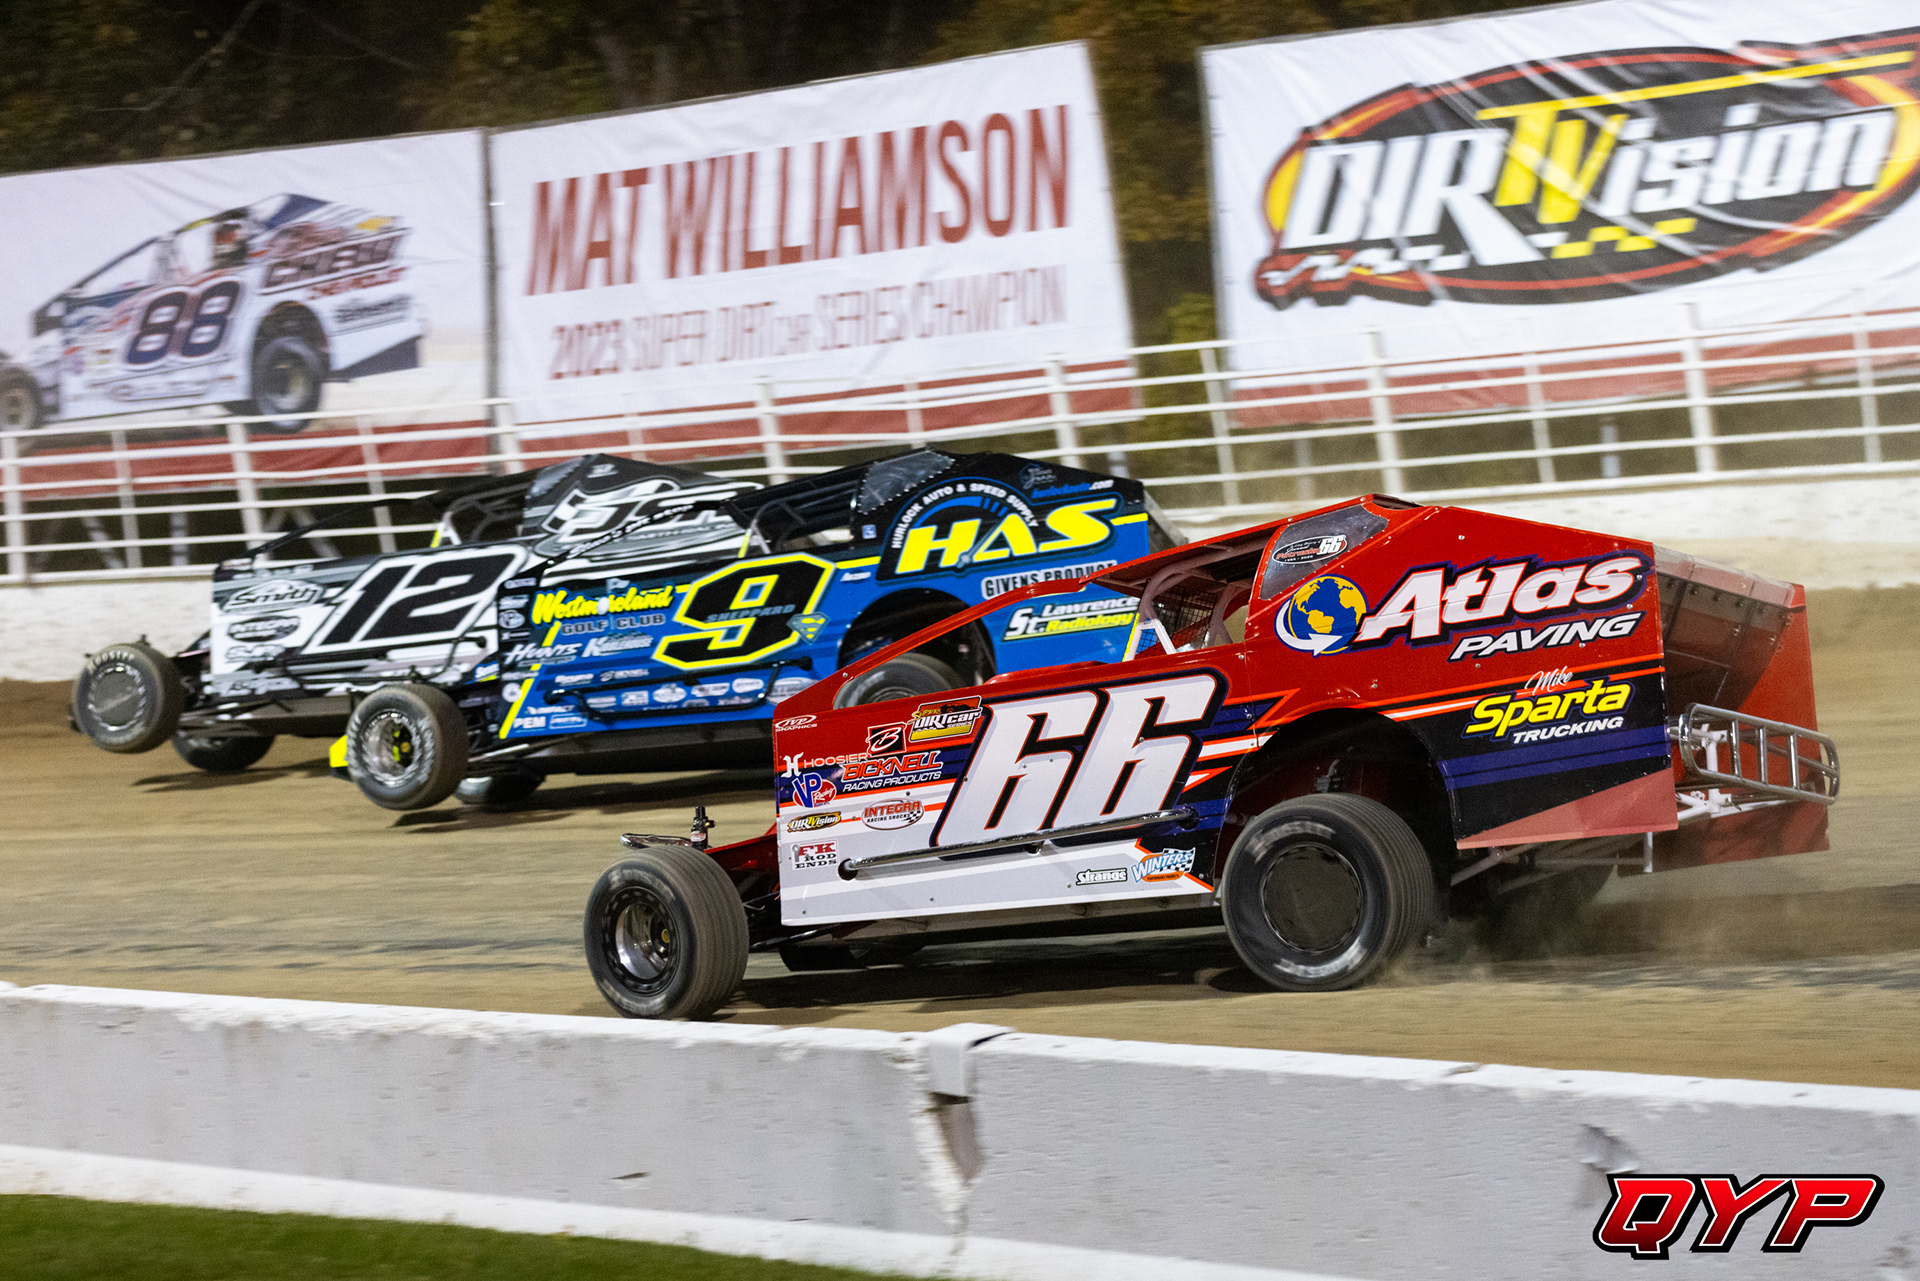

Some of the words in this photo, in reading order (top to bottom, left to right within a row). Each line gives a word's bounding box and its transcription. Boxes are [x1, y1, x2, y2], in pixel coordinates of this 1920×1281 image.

[524, 167, 650, 296] MAT
[664, 104, 1072, 279] WILLIAMSON
[127, 281, 240, 364] 88
[550, 319, 622, 379] 2023
[631, 310, 708, 371] SUPER
[815, 285, 904, 350] SERIES
[911, 265, 1067, 339] CHAMPION
[891, 503, 923, 548] HURLOCK
[922, 486, 953, 505] AUTO
[956, 483, 966, 492] &
[969, 483, 1006, 498] SPEED
[1006, 494, 1039, 527] SUPPLY
[895, 499, 1116, 574] HAS
[1317, 535, 1346, 555] 66
[318, 551, 518, 648] 12
[985, 573, 1039, 597] GIVENS
[1353, 557, 1642, 642] Atlas
[532, 585, 673, 624] Westmoreland
[652, 554, 837, 668] 9
[705, 604, 796, 623] SHEPPARD
[1005, 607, 1045, 637] St.
[1042, 597, 1140, 617] Lawrence
[561, 619, 608, 635] GOLF
[616, 613, 665, 629] CLUB
[1046, 613, 1134, 632] Radiology
[1449, 612, 1642, 660] PAVING
[1524, 666, 1573, 695] Mike
[914, 709, 980, 729] DIRTcar
[1466, 679, 1630, 737] Sparta
[1513, 716, 1624, 744] TRUCKING
[804, 753, 868, 768] HOOSIER
[842, 751, 943, 781] BICKNELL
[936, 673, 1217, 847] 66
[793, 773, 822, 808] VP
[843, 780, 883, 792] RACING
[883, 771, 942, 786] PRODUCTS
[864, 801, 921, 818] INTEGRA
[795, 859, 837, 869] ENDS
[798, 843, 836, 856] FK
[804, 853, 837, 861] ROD
[1077, 869, 1127, 885] Strange
[1131, 852, 1191, 883] WINTERS
